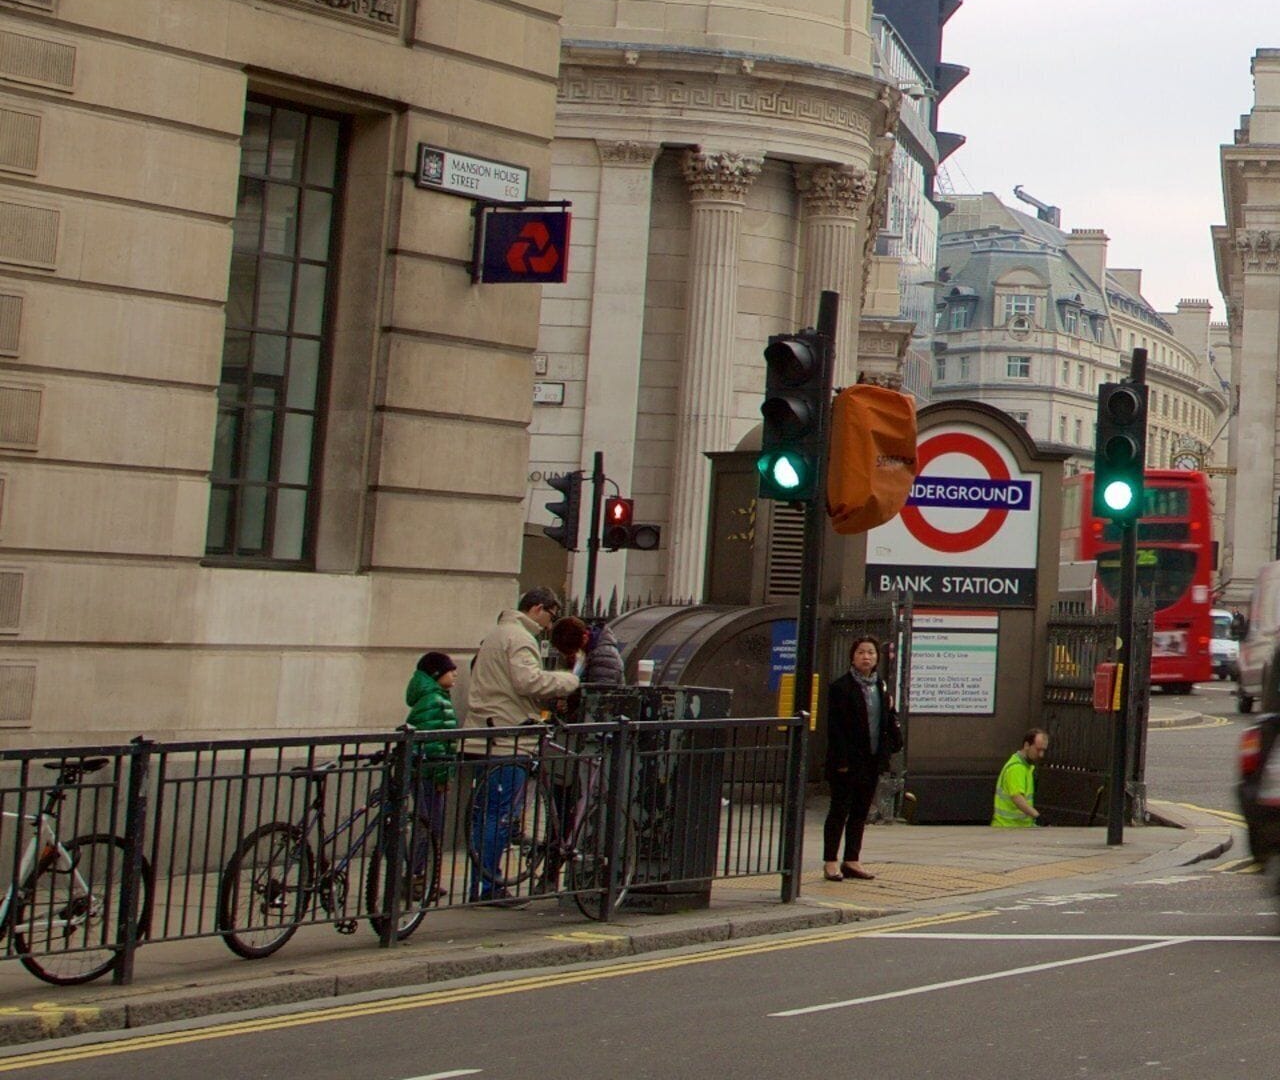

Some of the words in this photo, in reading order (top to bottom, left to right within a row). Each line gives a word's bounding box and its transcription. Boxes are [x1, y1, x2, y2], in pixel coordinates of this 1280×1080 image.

[451, 159, 491, 177] MANSION
[494, 167, 519, 185] HOUSE
[451, 173, 480, 189] STREET
[505, 185, 519, 198] EC2
[909, 484, 1023, 505] NDERGROUND
[880, 575, 933, 592] BANK
[942, 576, 1019, 594] STATION
